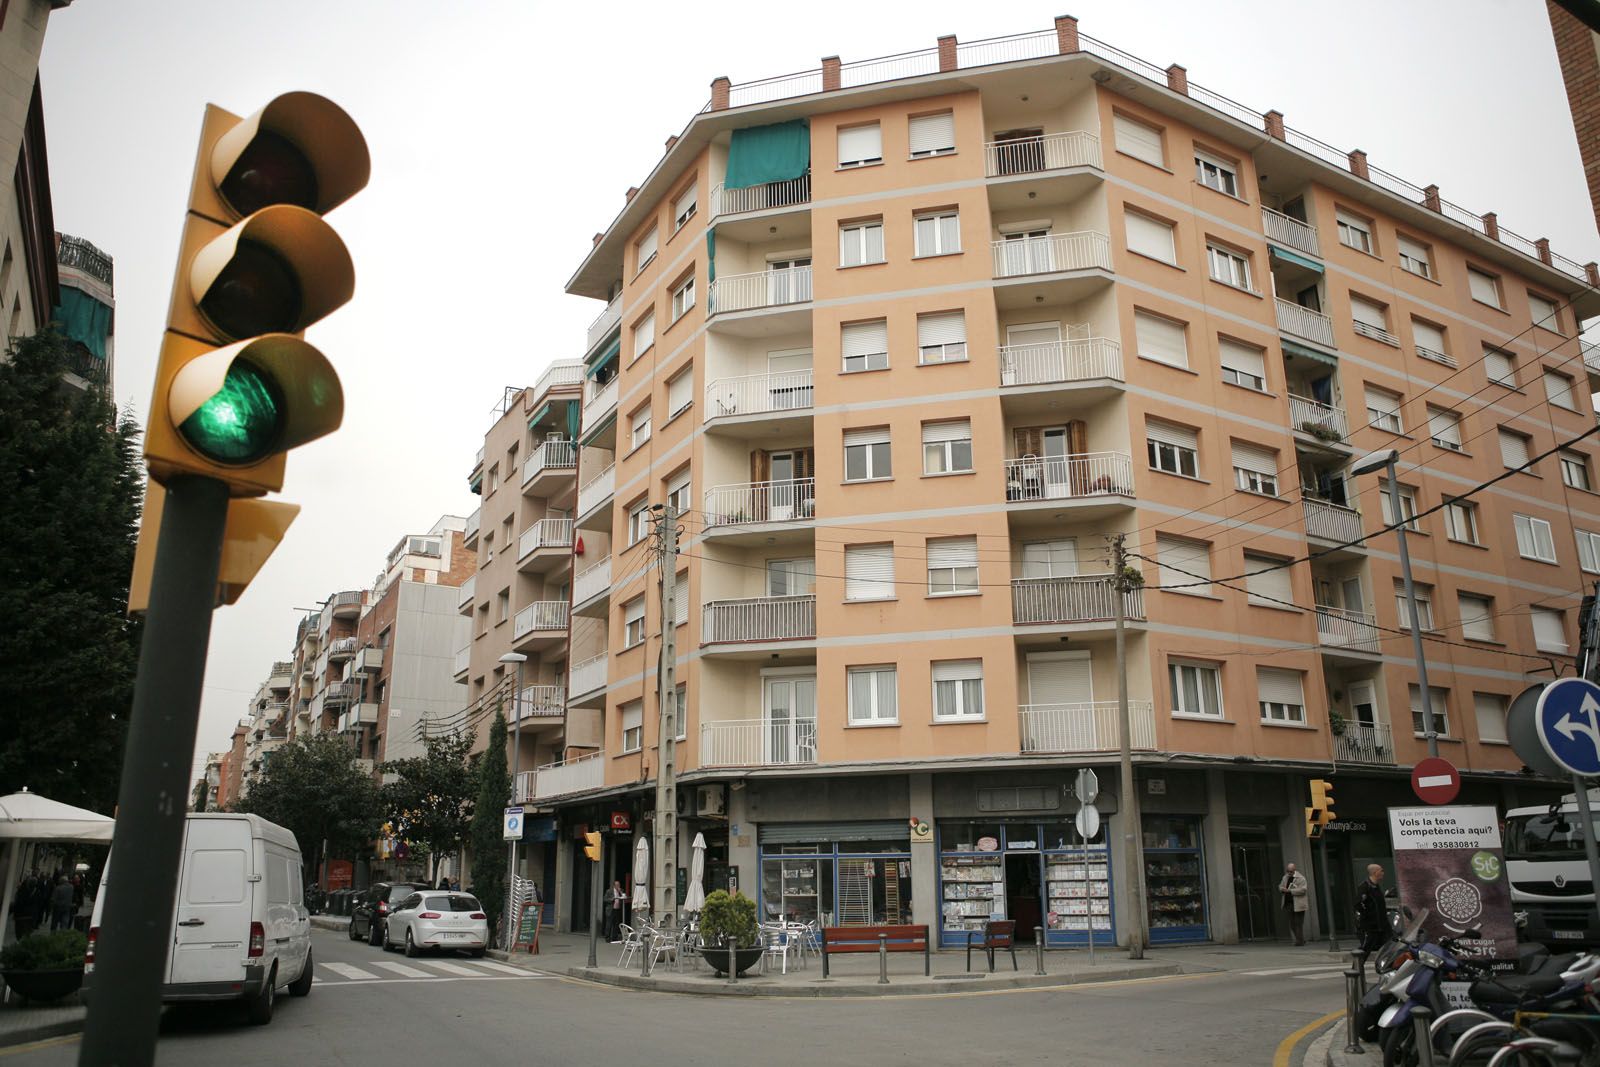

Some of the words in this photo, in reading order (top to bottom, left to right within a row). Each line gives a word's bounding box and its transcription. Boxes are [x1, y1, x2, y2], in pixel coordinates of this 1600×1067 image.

[613, 815, 628, 825] CX
[1399, 818, 1420, 826] Vols
[1423, 818, 1432, 826] la
[1435, 818, 1456, 826] teva
